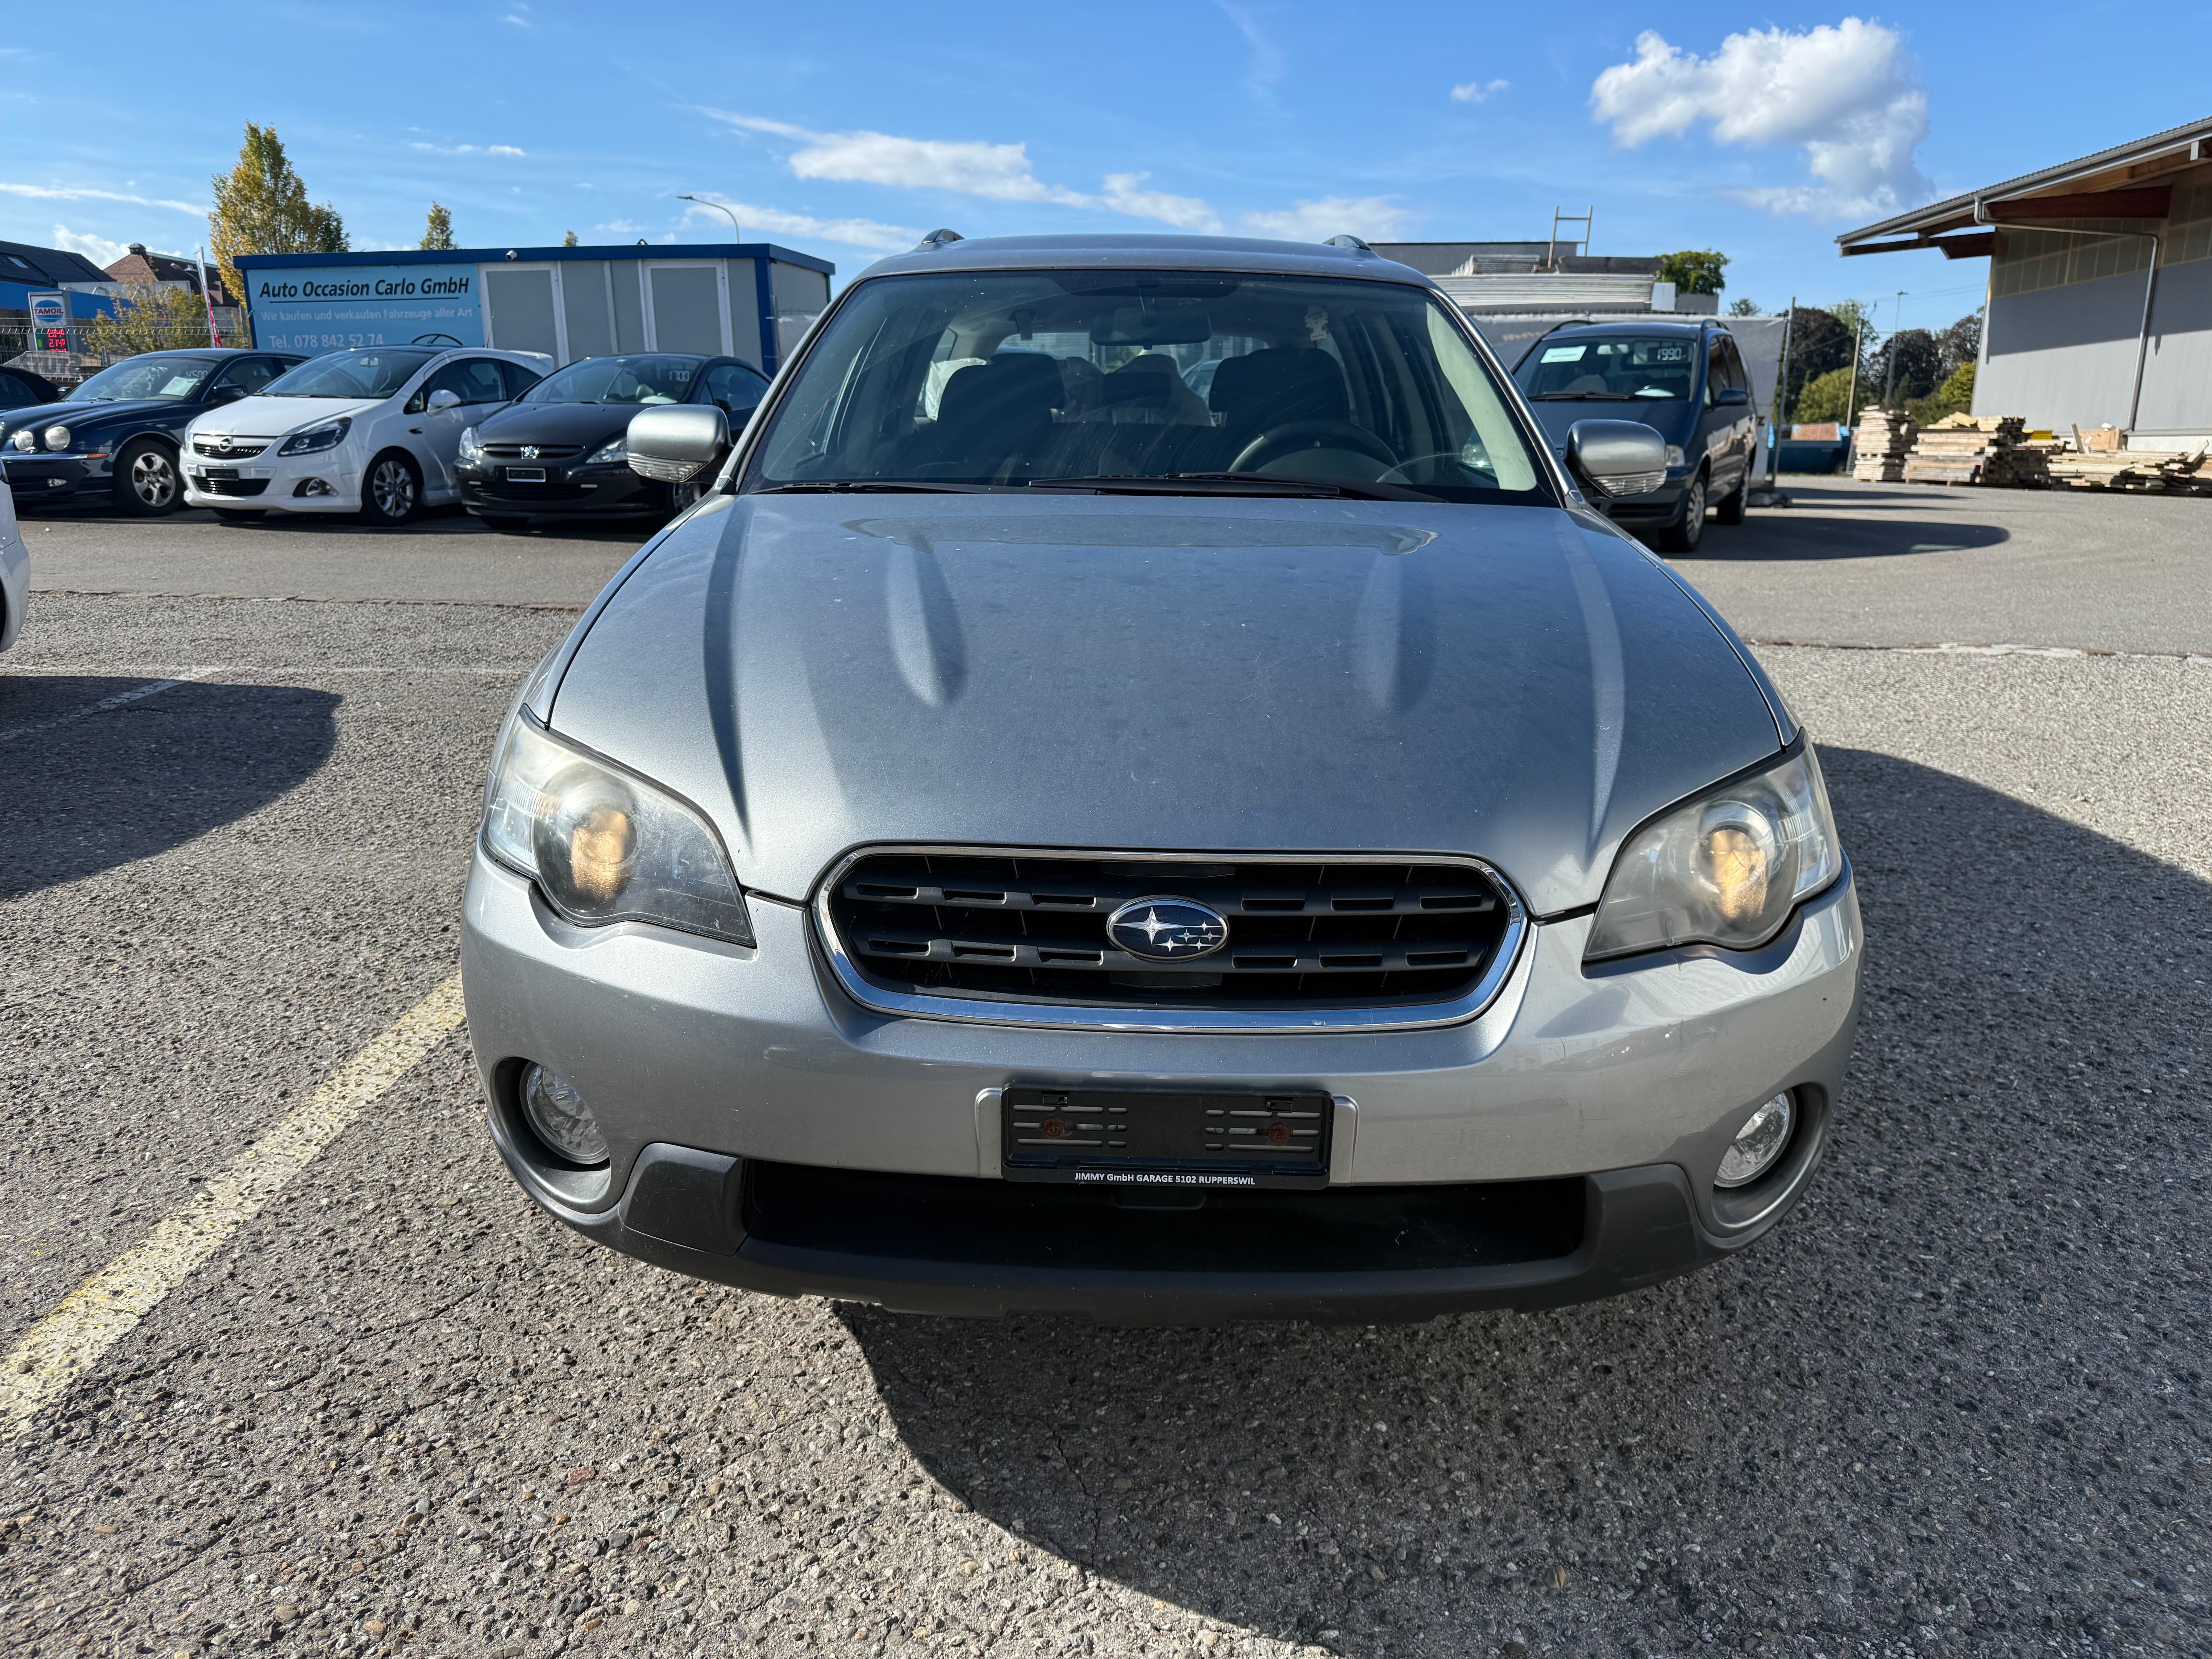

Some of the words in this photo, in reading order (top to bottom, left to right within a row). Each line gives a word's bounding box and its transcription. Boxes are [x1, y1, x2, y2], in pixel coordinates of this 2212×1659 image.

[259, 282, 297, 297] Auto
[302, 280, 369, 297] Occasion
[375, 278, 416, 295] Carlo
[421, 277, 469, 294] GmbH
[261, 311, 277, 321] Wir
[280, 311, 312, 321] kaufen
[315, 310, 332, 320] und
[335, 309, 381, 319] verkaufen
[384, 308, 432, 320] Fahrzeuge
[435, 307, 454, 317] aller
[458, 308, 472, 317] Art
[268, 334, 291, 348] Tel.
[295, 335, 318, 347] 078
[321, 334, 345, 347] 842
[349, 334, 364, 347] 52
[368, 334, 384, 346] 74
[1199, 1176, 1255, 1185] RUPPERSWIL
